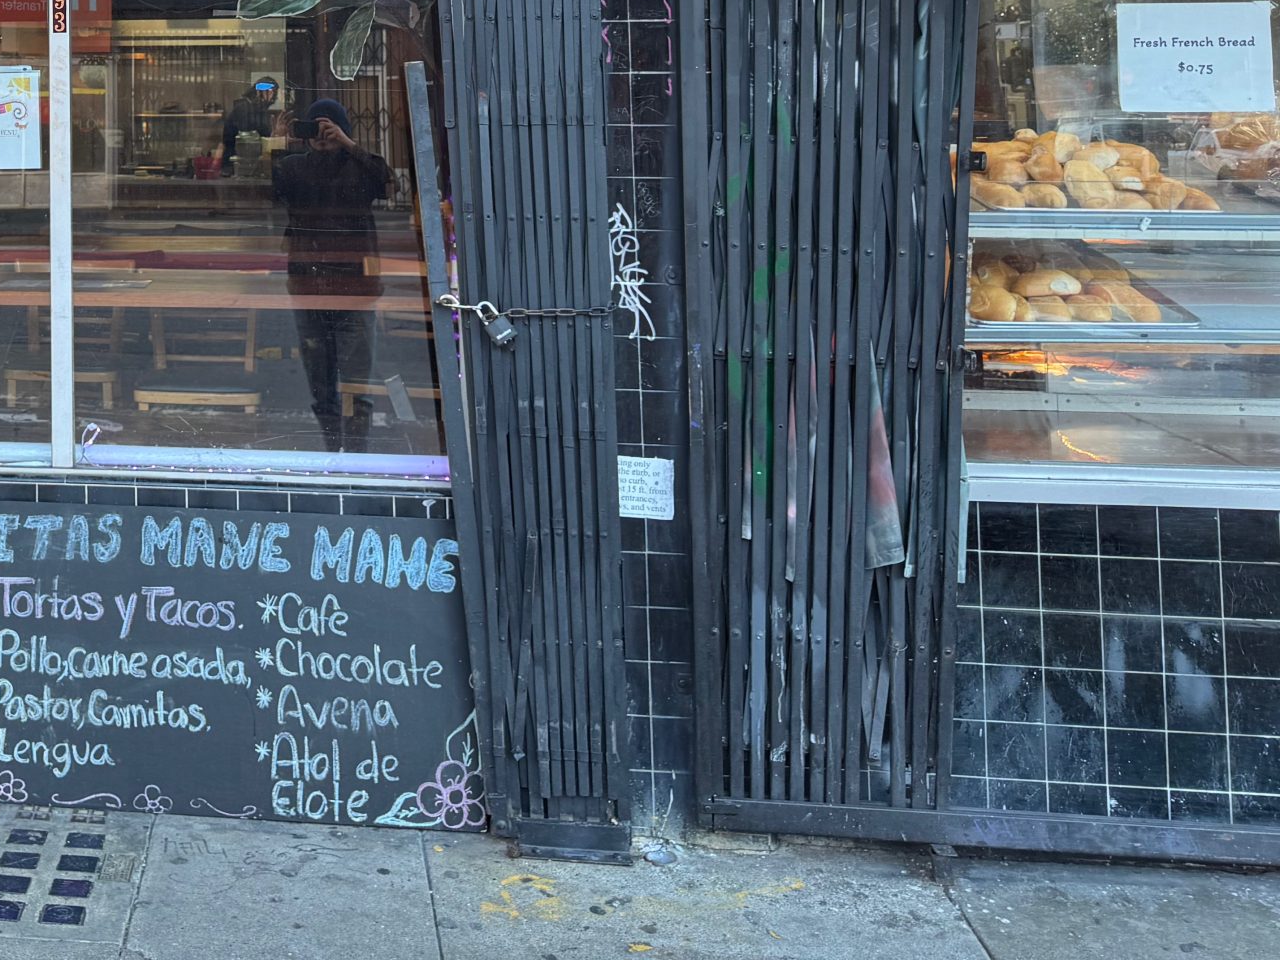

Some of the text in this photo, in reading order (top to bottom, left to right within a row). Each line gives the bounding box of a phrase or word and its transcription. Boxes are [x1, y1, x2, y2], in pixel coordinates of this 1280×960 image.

[1133, 36, 1256, 48] Fresh French Bread
[1178, 62, 1213, 74] $0.75
[140, 514, 292, 572] MANE
[310, 525, 460, 593] MANE
[115, 593, 138, 638] y
[141, 586, 243, 631] Tacos.
[274, 638, 444, 689] Chocolate
[276, 684, 399, 730] Avena
[271, 731, 400, 783] Atol de
[272, 780, 370, 823] Elote
